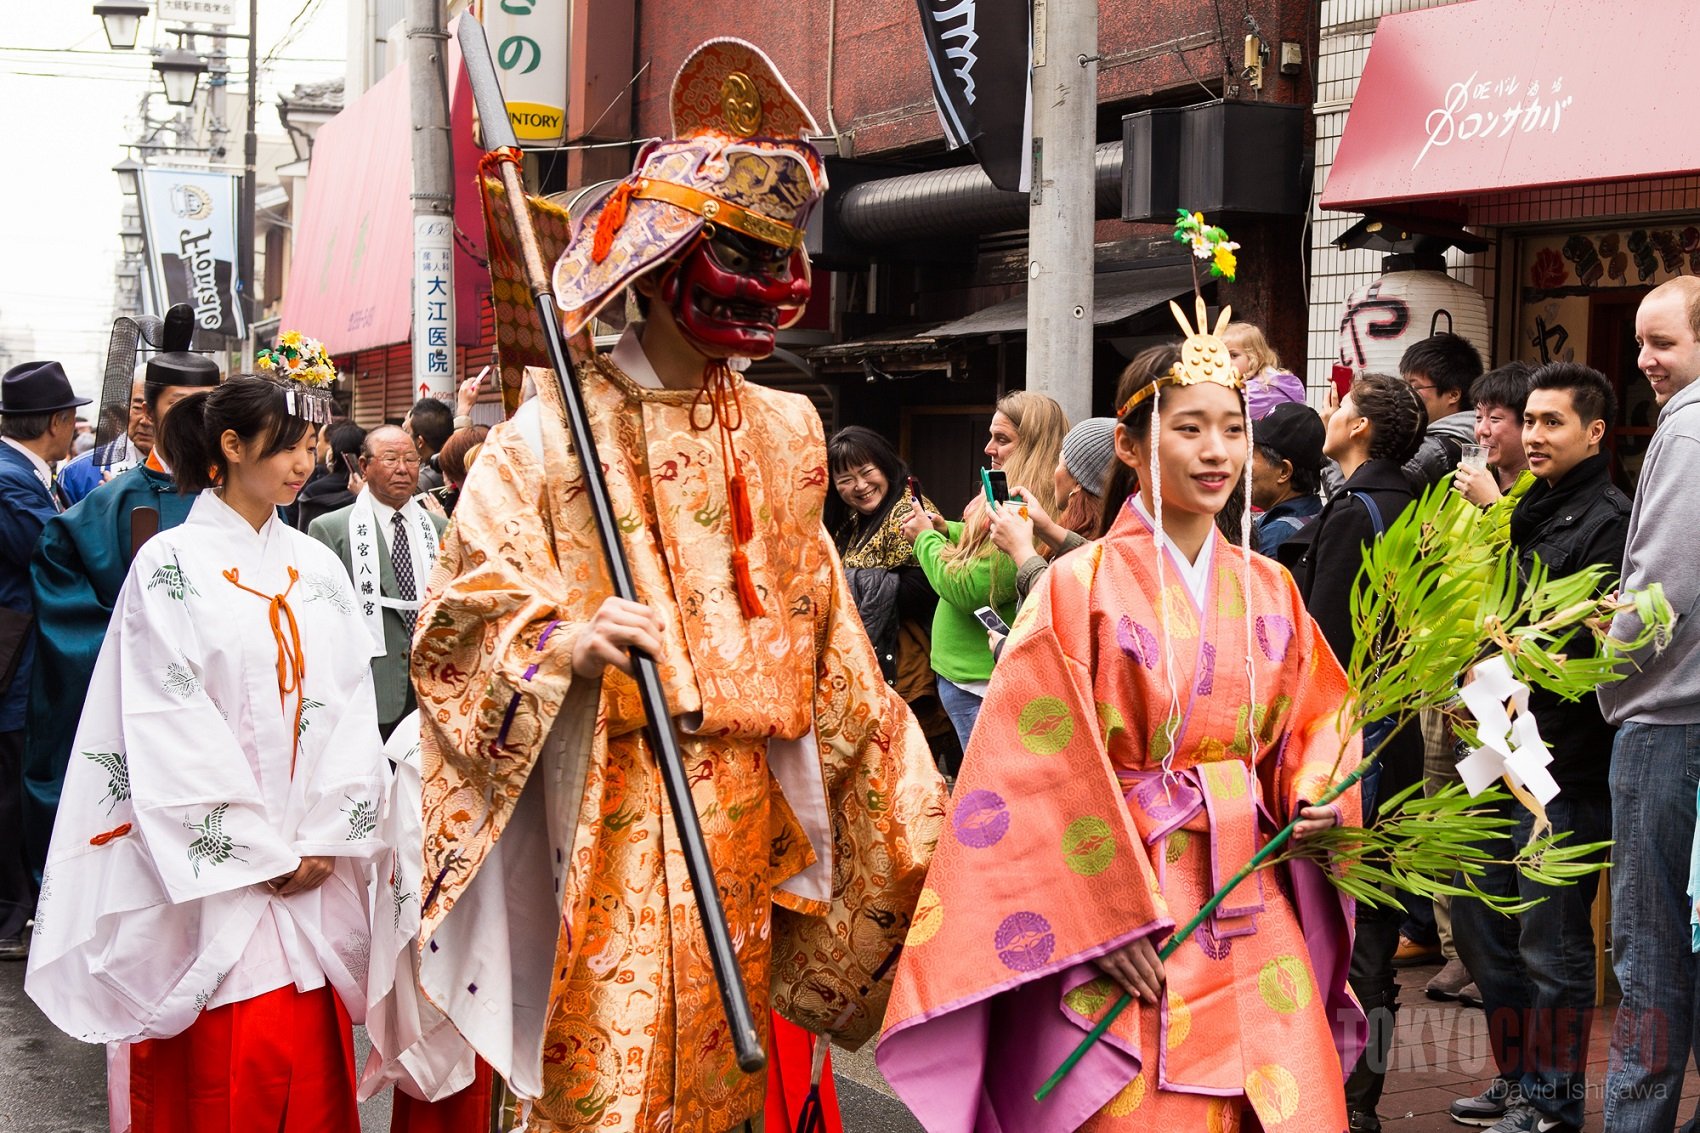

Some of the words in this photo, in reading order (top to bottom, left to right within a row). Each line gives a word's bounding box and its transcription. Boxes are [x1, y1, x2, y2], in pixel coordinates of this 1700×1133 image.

[508, 112, 560, 128] NTORY
[427, 276, 448, 372] 大江医院
[357, 523, 375, 616] 若宮八幡宮
